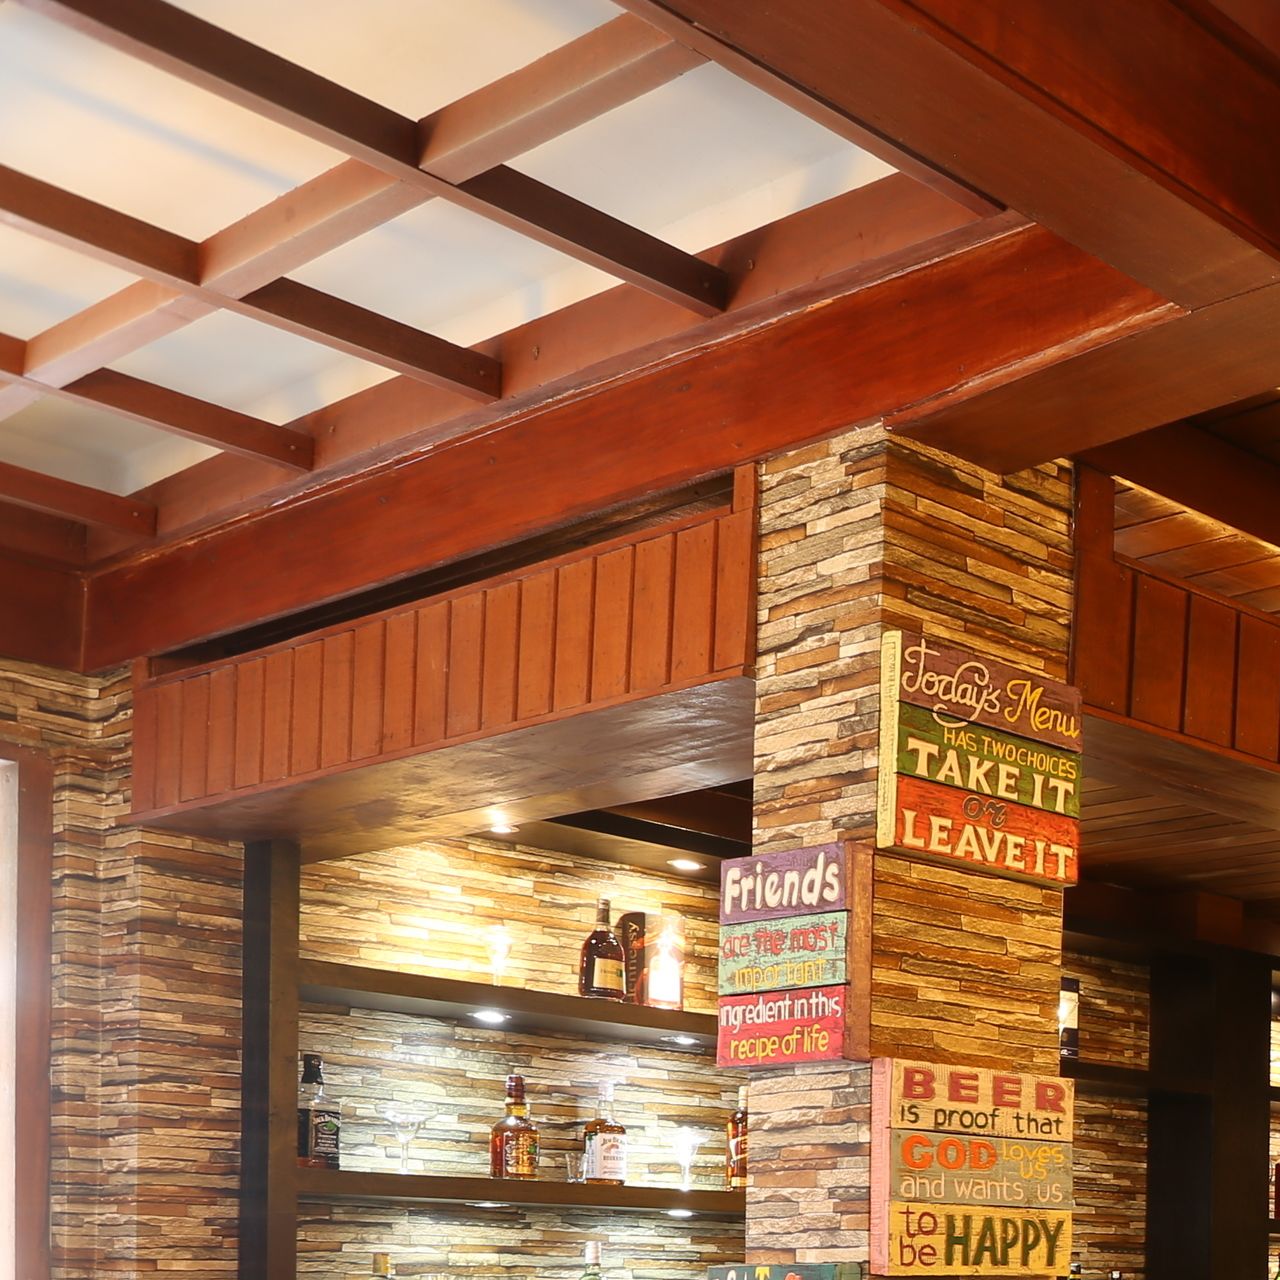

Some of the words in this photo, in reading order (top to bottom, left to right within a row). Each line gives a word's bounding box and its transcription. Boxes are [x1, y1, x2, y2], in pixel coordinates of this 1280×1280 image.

[902, 638, 1001, 728] Today's
[1004, 680, 1080, 738] Menu
[943, 727, 977, 751] HAS
[981, 736, 1016, 761] TWO
[1017, 748, 1077, 779] CHOICES
[907, 737, 1020, 800] TAKE
[1032, 773, 1074, 814] IT
[902, 808, 1025, 870] LEAVE
[1034, 839, 1073, 879] IT
[725, 852, 840, 914] Friends
[721, 933, 750, 959] are
[753, 928, 787, 955] the
[790, 921, 839, 952] most
[720, 993, 792, 1033] ingredient
[809, 991, 841, 1018] this
[730, 1033, 779, 1062] recipe
[781, 1024, 802, 1055] of
[803, 1024, 829, 1053] life
[902, 1066, 1066, 1115] BEER
[934, 1107, 1000, 1130] proof
[1013, 1112, 1063, 1135] that
[902, 1134, 997, 1171] GOD
[900, 1173, 945, 1199] and
[954, 1177, 1024, 1201] wants
[1037, 1183, 1063, 1203] us
[899, 1205, 938, 1238] to
[944, 1214, 1064, 1267] HAPPY
[899, 1236, 937, 1267] be
